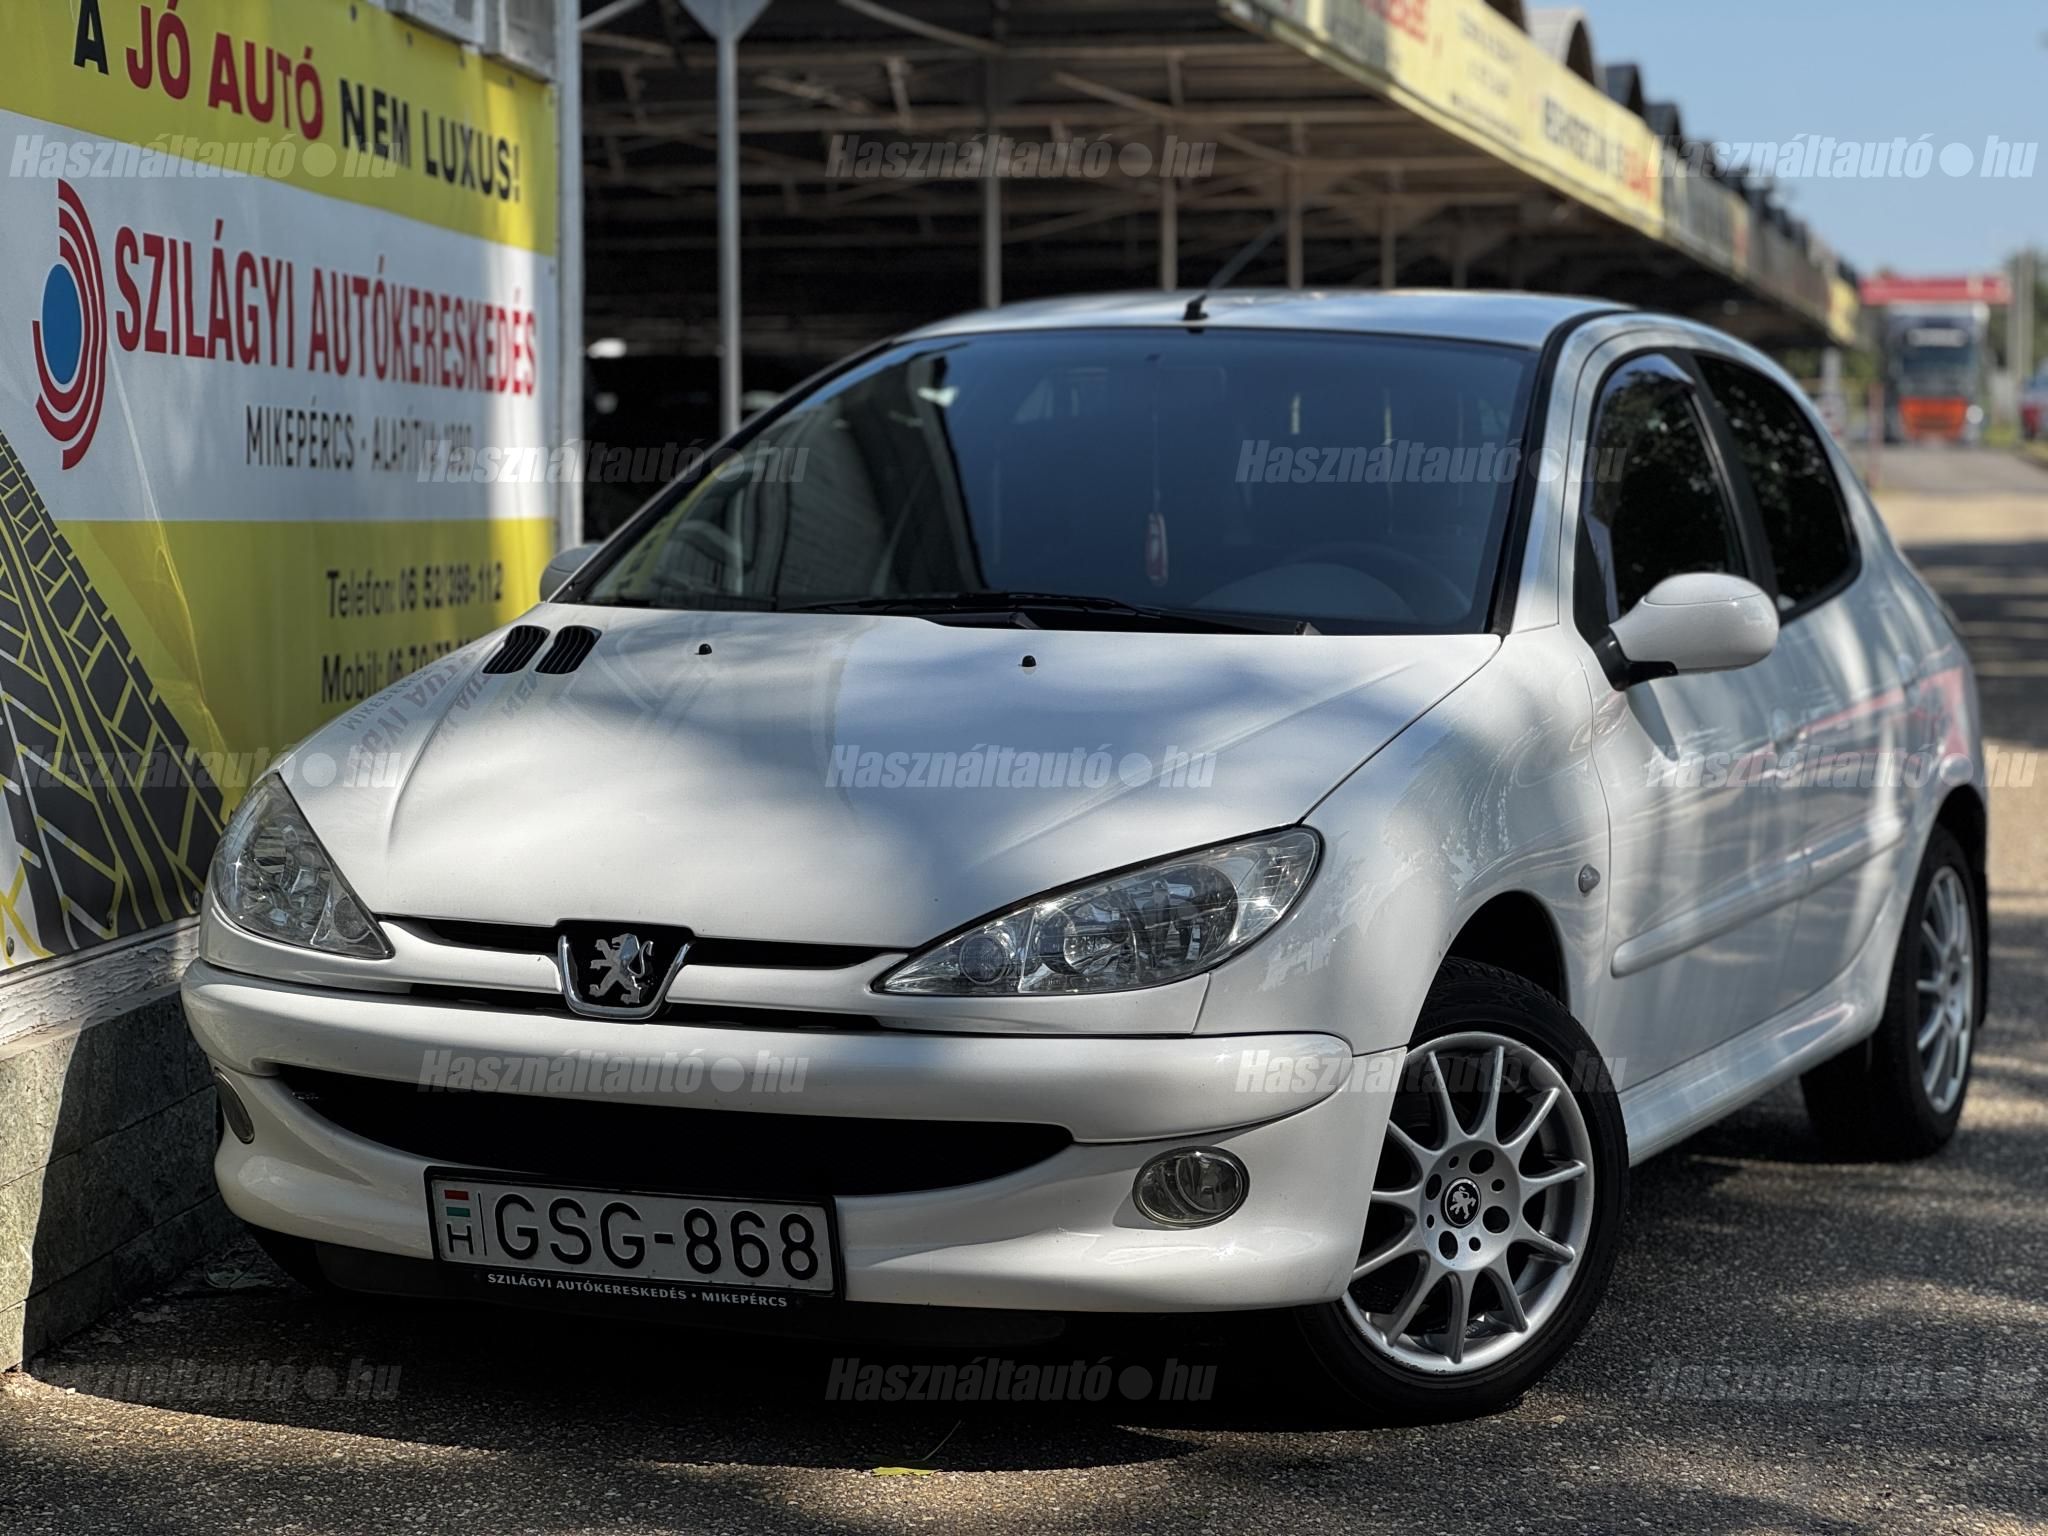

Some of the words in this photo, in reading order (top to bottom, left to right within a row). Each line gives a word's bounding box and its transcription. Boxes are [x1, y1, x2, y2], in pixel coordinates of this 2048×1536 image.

[74, 0, 109, 75] A
[126, 0, 190, 99] JÓ
[208, 33, 324, 140] AUTÓ
[340, 78, 411, 169] NEM
[422, 110, 521, 203] LUXUS!
[115, 218, 294, 368] SZILÁGYI
[308, 255, 537, 398] AUTÓKERESKEDÉS
[246, 395, 355, 471] MIKEPÉRCS
[446, 1223, 474, 1255] H
[494, 1192, 819, 1281] GSG-868
[487, 1273, 552, 1289] SZILÁGYI
[556, 1278, 688, 1300] AUTÓKERESKEDÉS
[701, 1291, 789, 1307] MIKEPÉRCS
